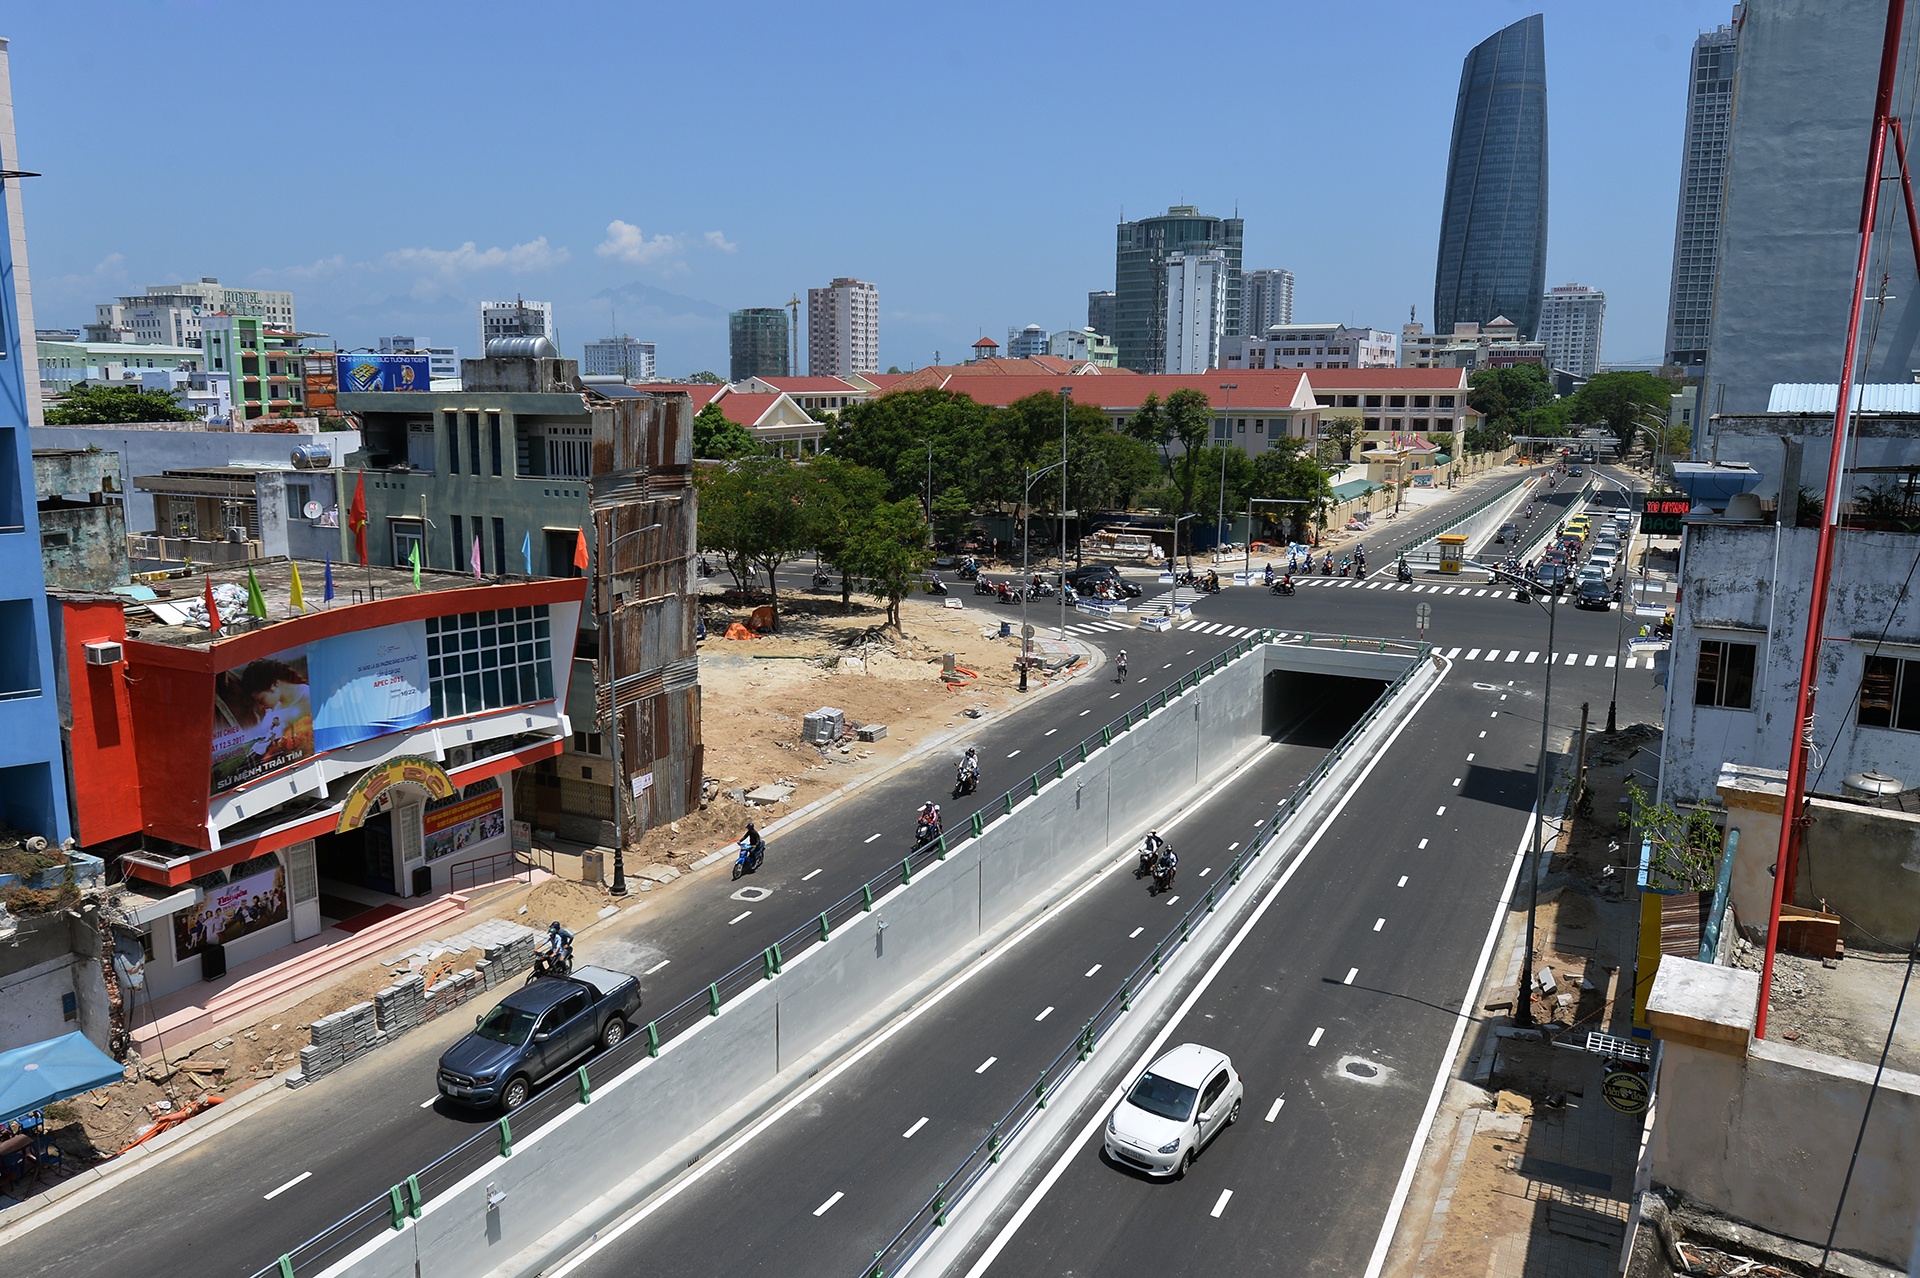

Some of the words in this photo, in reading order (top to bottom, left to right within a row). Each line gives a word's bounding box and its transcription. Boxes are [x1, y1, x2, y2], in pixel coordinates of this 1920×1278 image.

[224, 291, 263, 304] HOTEL
[373, 679, 389, 688] APEC
[390, 675, 404, 684] 2017
[263, 756, 285, 771] TRÁI
